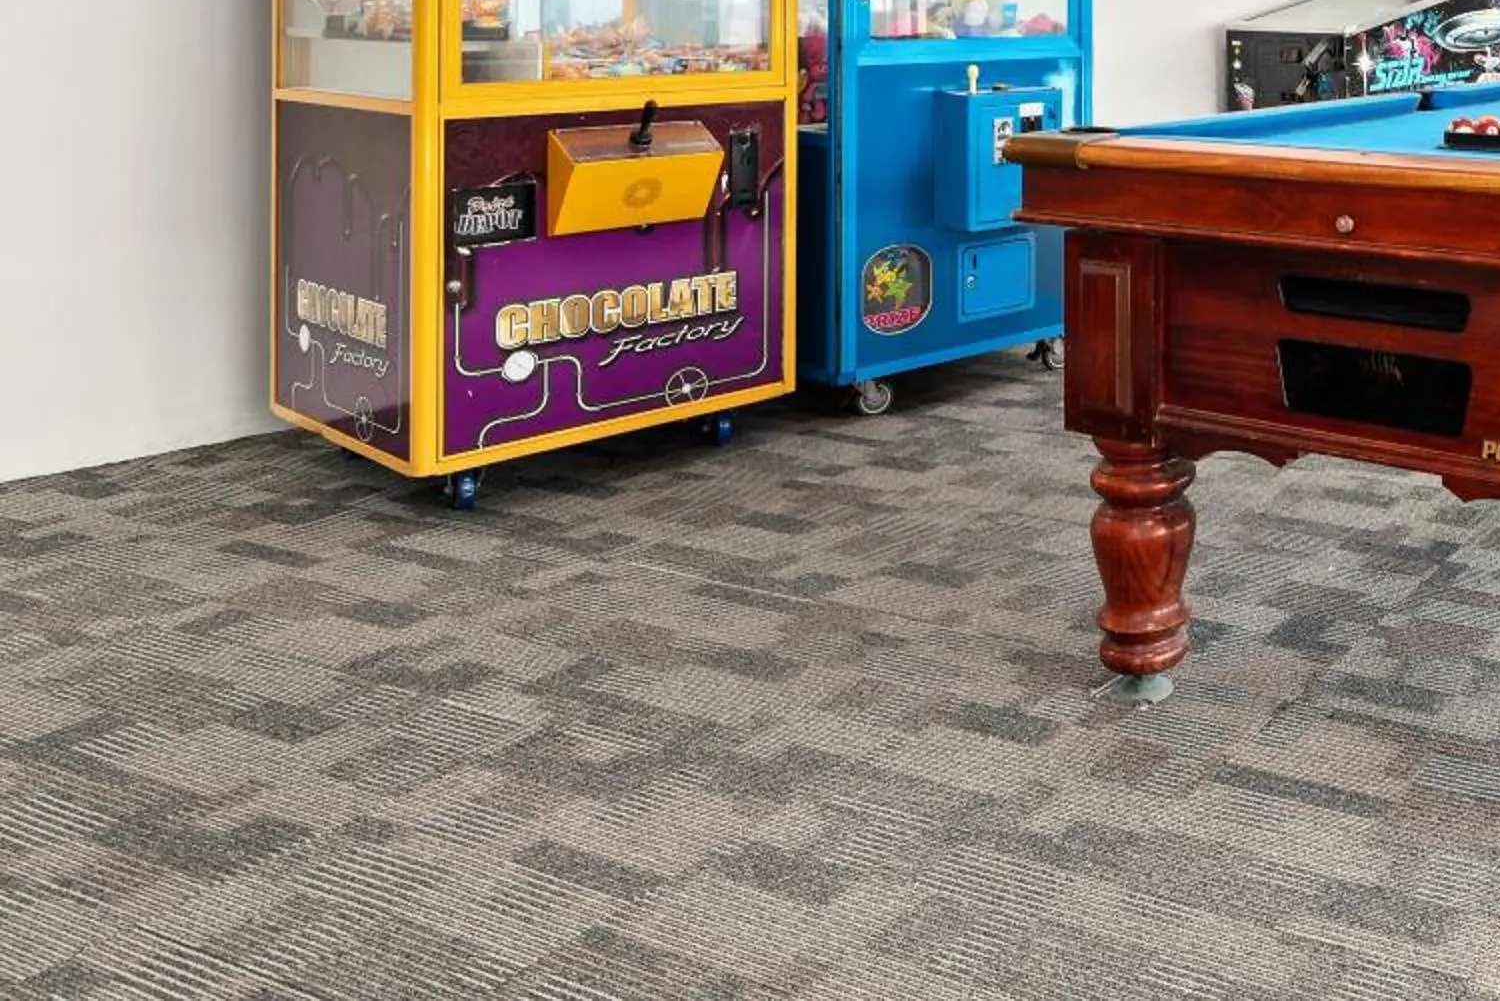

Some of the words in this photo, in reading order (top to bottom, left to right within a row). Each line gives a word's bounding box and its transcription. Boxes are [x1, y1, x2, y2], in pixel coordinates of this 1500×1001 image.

[297, 278, 387, 350] CHOCOLATE
[496, 270, 738, 350] CHOCOLATE
[598, 315, 745, 367] Factory
[329, 341, 391, 378] Factory
